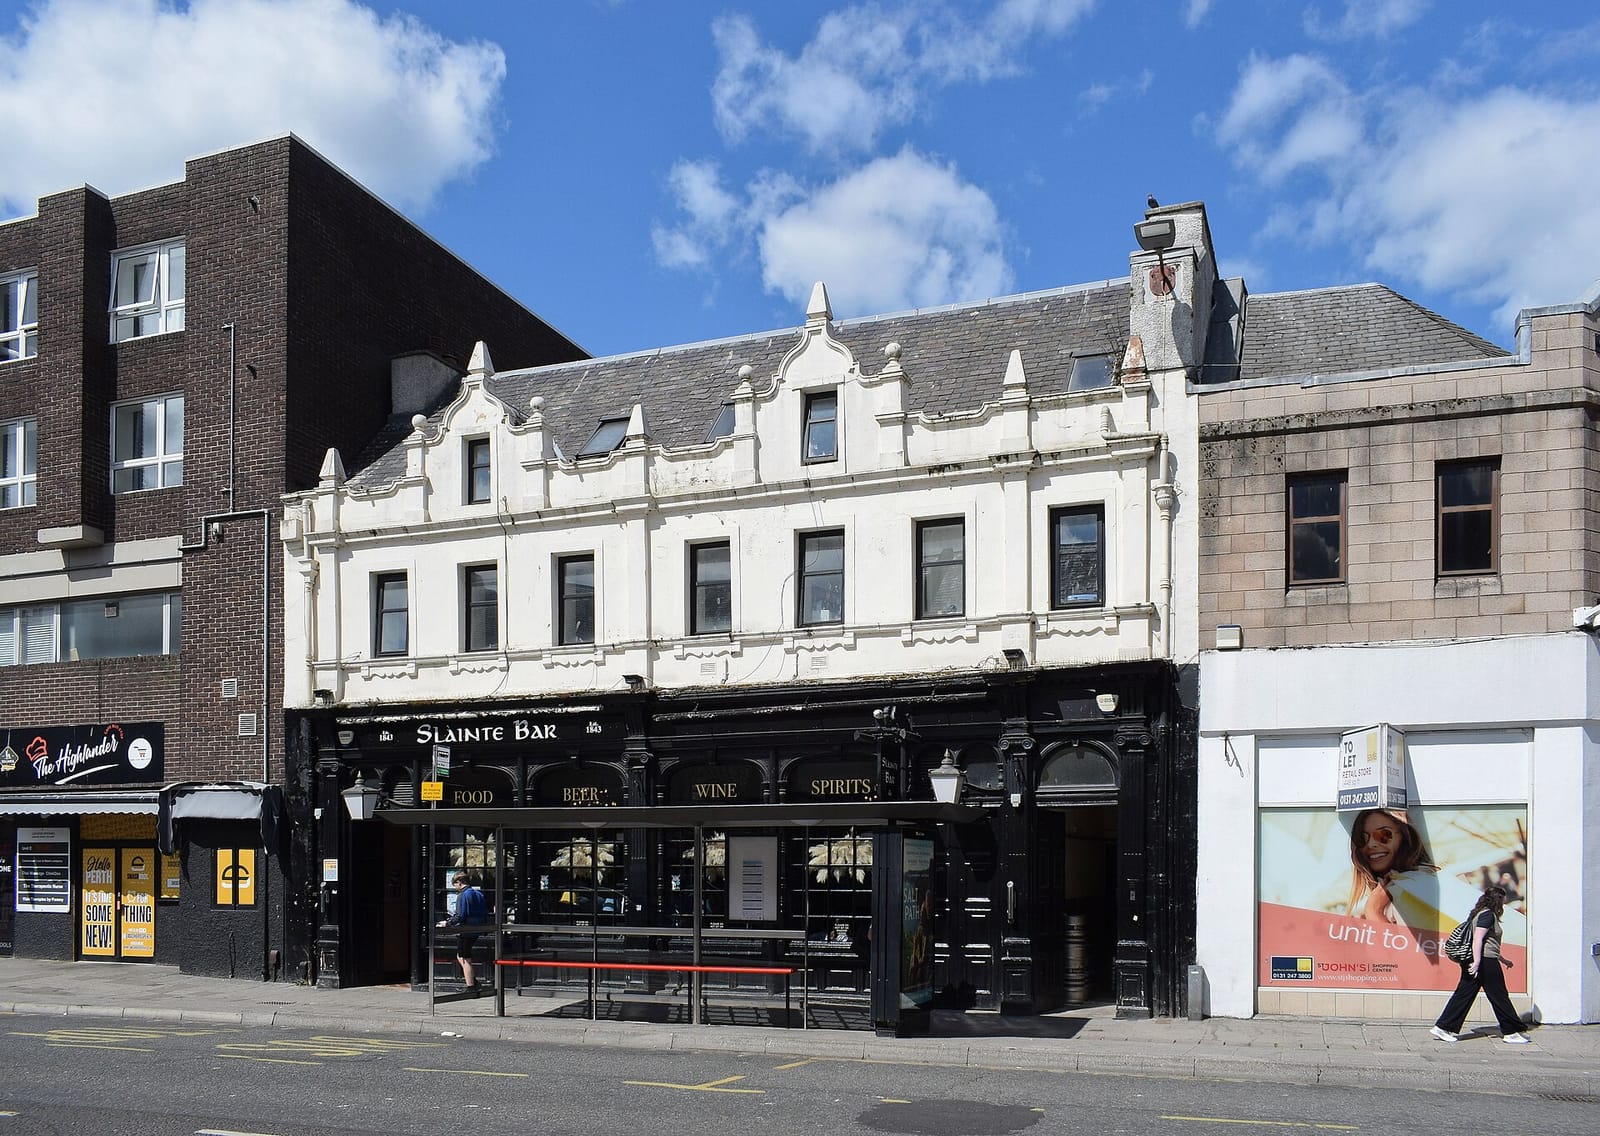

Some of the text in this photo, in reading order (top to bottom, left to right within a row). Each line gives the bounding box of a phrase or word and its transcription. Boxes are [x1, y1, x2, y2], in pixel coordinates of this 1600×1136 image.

[586, 725, 602, 734] 1843
[1344, 741, 1354, 754] TO
[33, 734, 119, 779] The Highlander
[1343, 755, 1357, 768] LET
[563, 787, 599, 802] BEER
[695, 783, 738, 798] WINE
[811, 778, 871, 796] SPIRITS
[454, 790, 493, 805] FOOD
[1339, 794, 1351, 805] 0131
[1351, 792, 1363, 804] 247
[1363, 791, 1378, 803] 3800
[87, 856, 111, 872] Hello
[86, 870, 112, 884] PERTH
[97, 892, 112, 903] TIME
[86, 905, 112, 922] SOME
[124, 905, 152, 923] THING
[904, 905, 920, 921] PATH
[86, 924, 112, 948] NEW!
[1328, 923, 1446, 958] unit to let
[1321, 963, 1367, 972] JOHN'S
